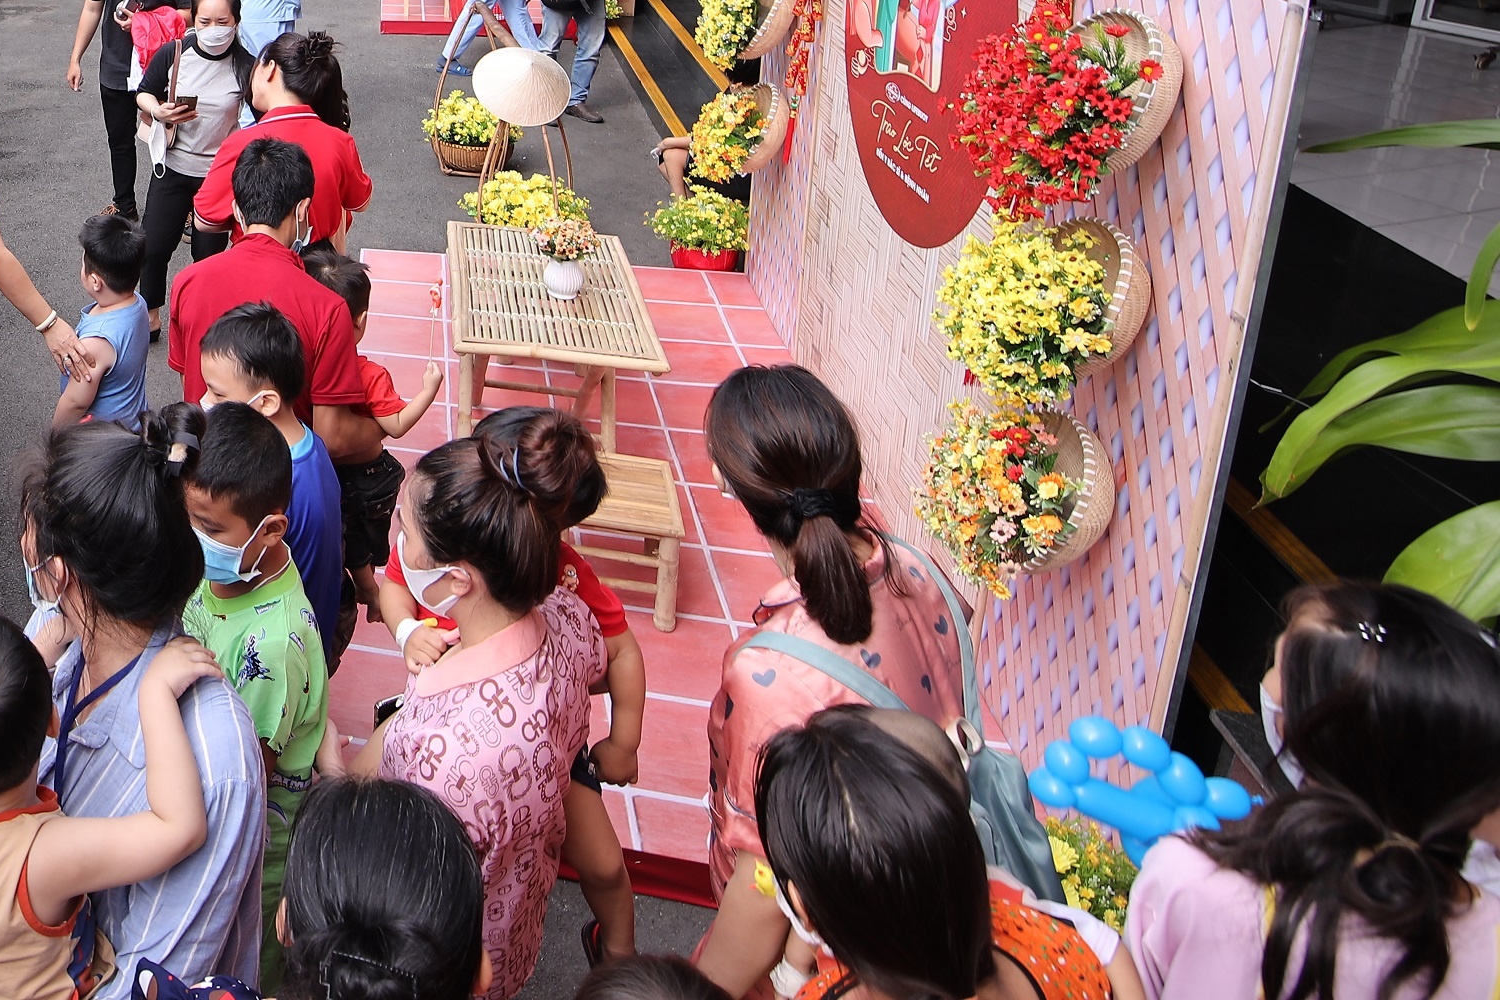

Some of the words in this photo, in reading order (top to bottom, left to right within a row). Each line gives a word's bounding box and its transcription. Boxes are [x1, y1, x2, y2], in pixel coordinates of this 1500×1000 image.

[871, 99, 897, 142] Trao
[893, 119, 915, 160] Lộc
[915, 135, 942, 173] Tết
